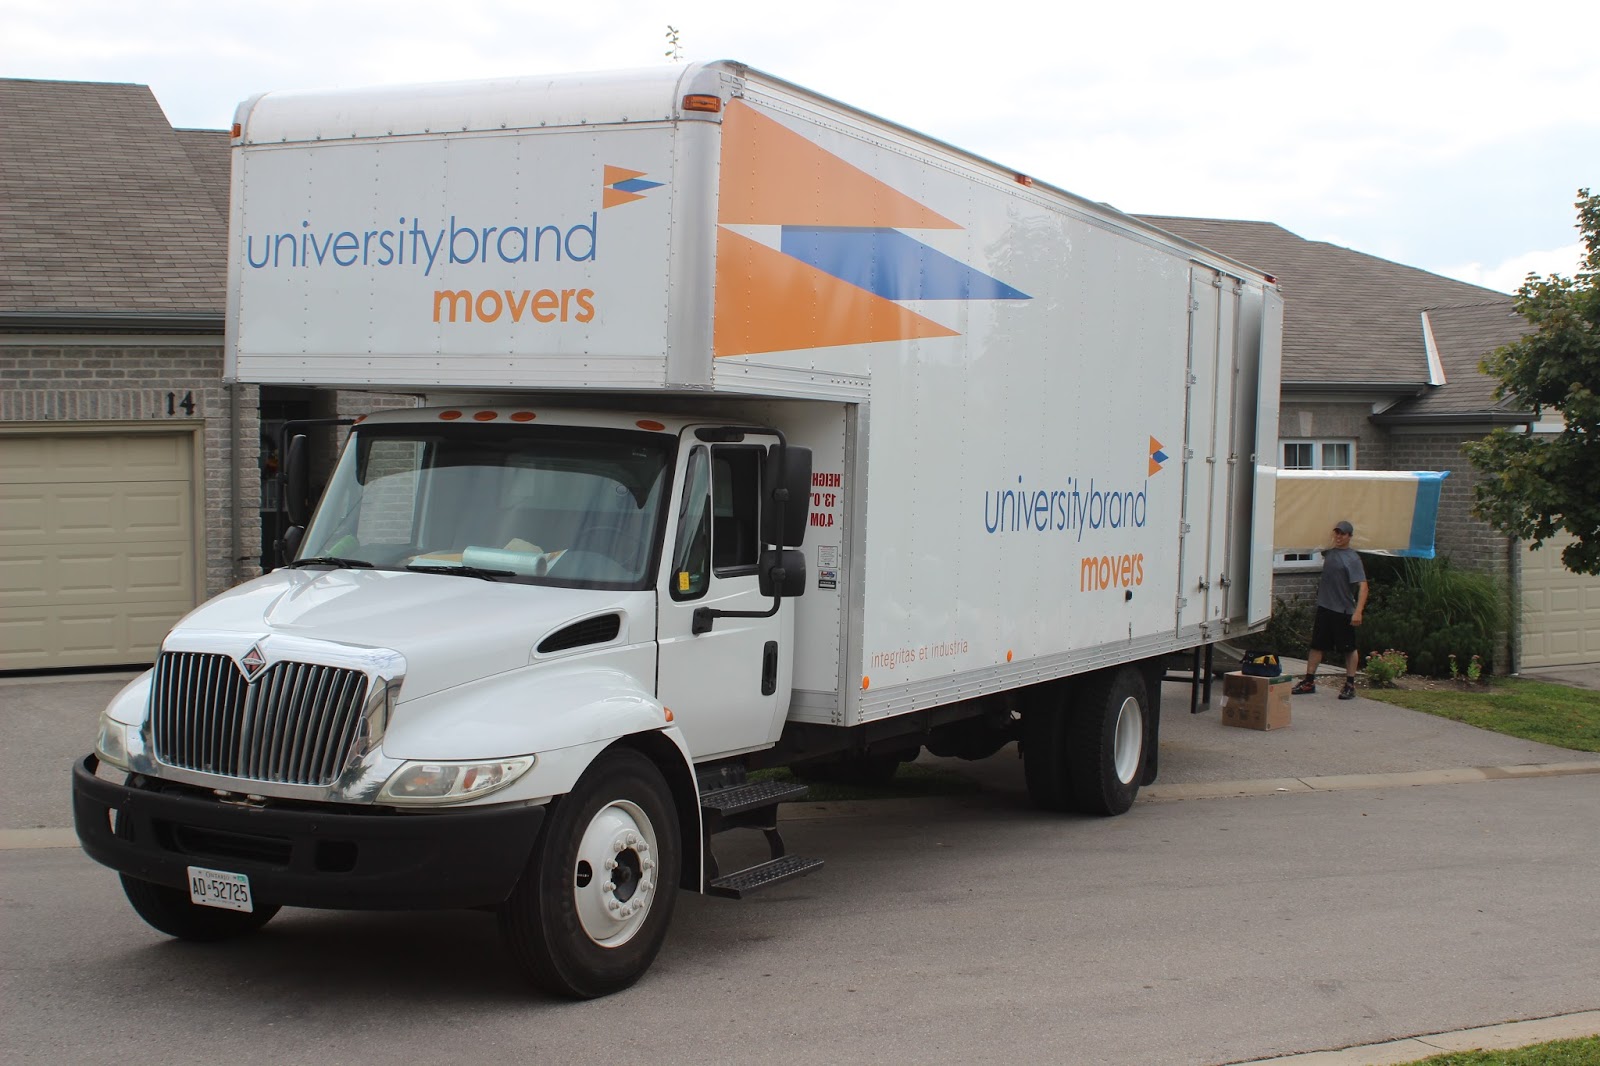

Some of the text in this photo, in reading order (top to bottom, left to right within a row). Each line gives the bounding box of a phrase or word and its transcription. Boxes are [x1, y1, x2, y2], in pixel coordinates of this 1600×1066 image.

[247, 212, 598, 277] universitybrand
[432, 287, 596, 324] movers
[167, 391, 196, 416] 14
[984, 474, 1148, 543] universitybrand
[1079, 552, 1144, 593] movers
[870, 640, 968, 670] integritas et industria
